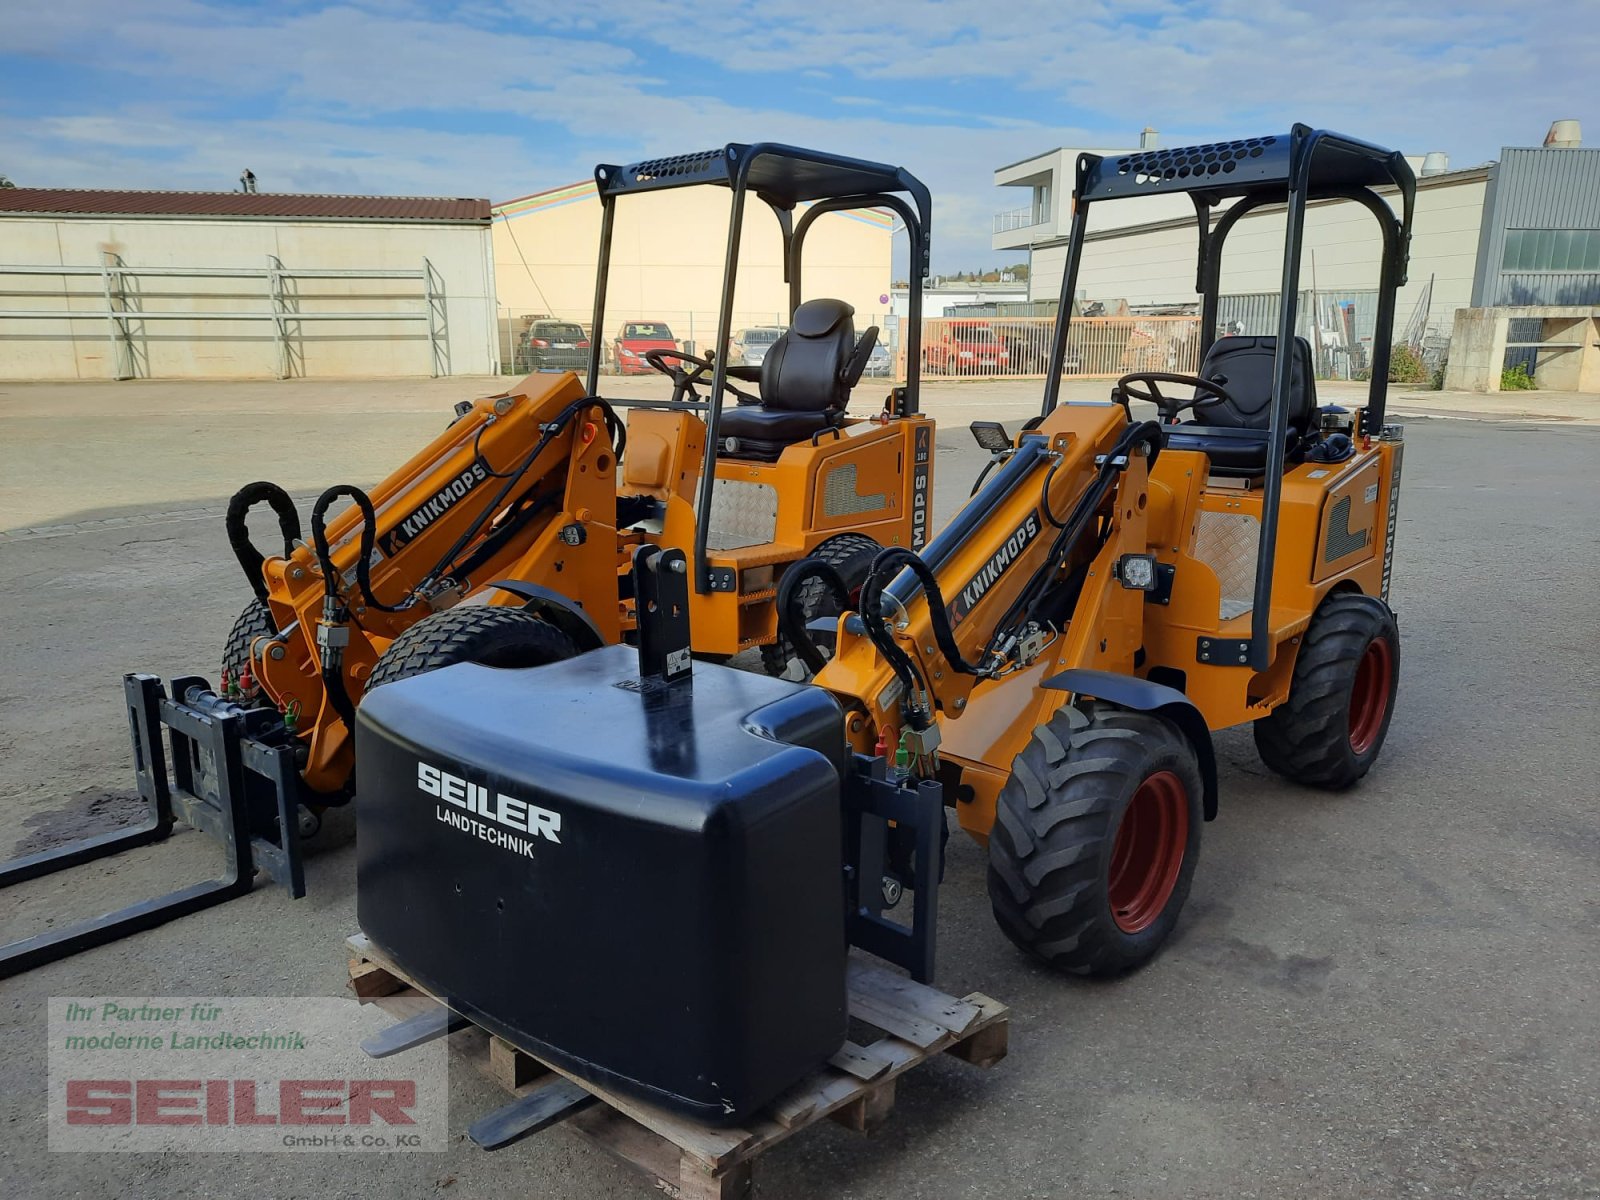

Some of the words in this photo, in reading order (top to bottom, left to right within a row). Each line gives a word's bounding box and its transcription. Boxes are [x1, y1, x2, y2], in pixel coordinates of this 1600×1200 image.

[402, 463, 486, 538] KNIKMOPS
[912, 475, 926, 554] MOPS
[963, 516, 1037, 609] KNIKMOPS
[417, 761, 562, 844] SEILER
[436, 804, 534, 859] LANDTECHNIK
